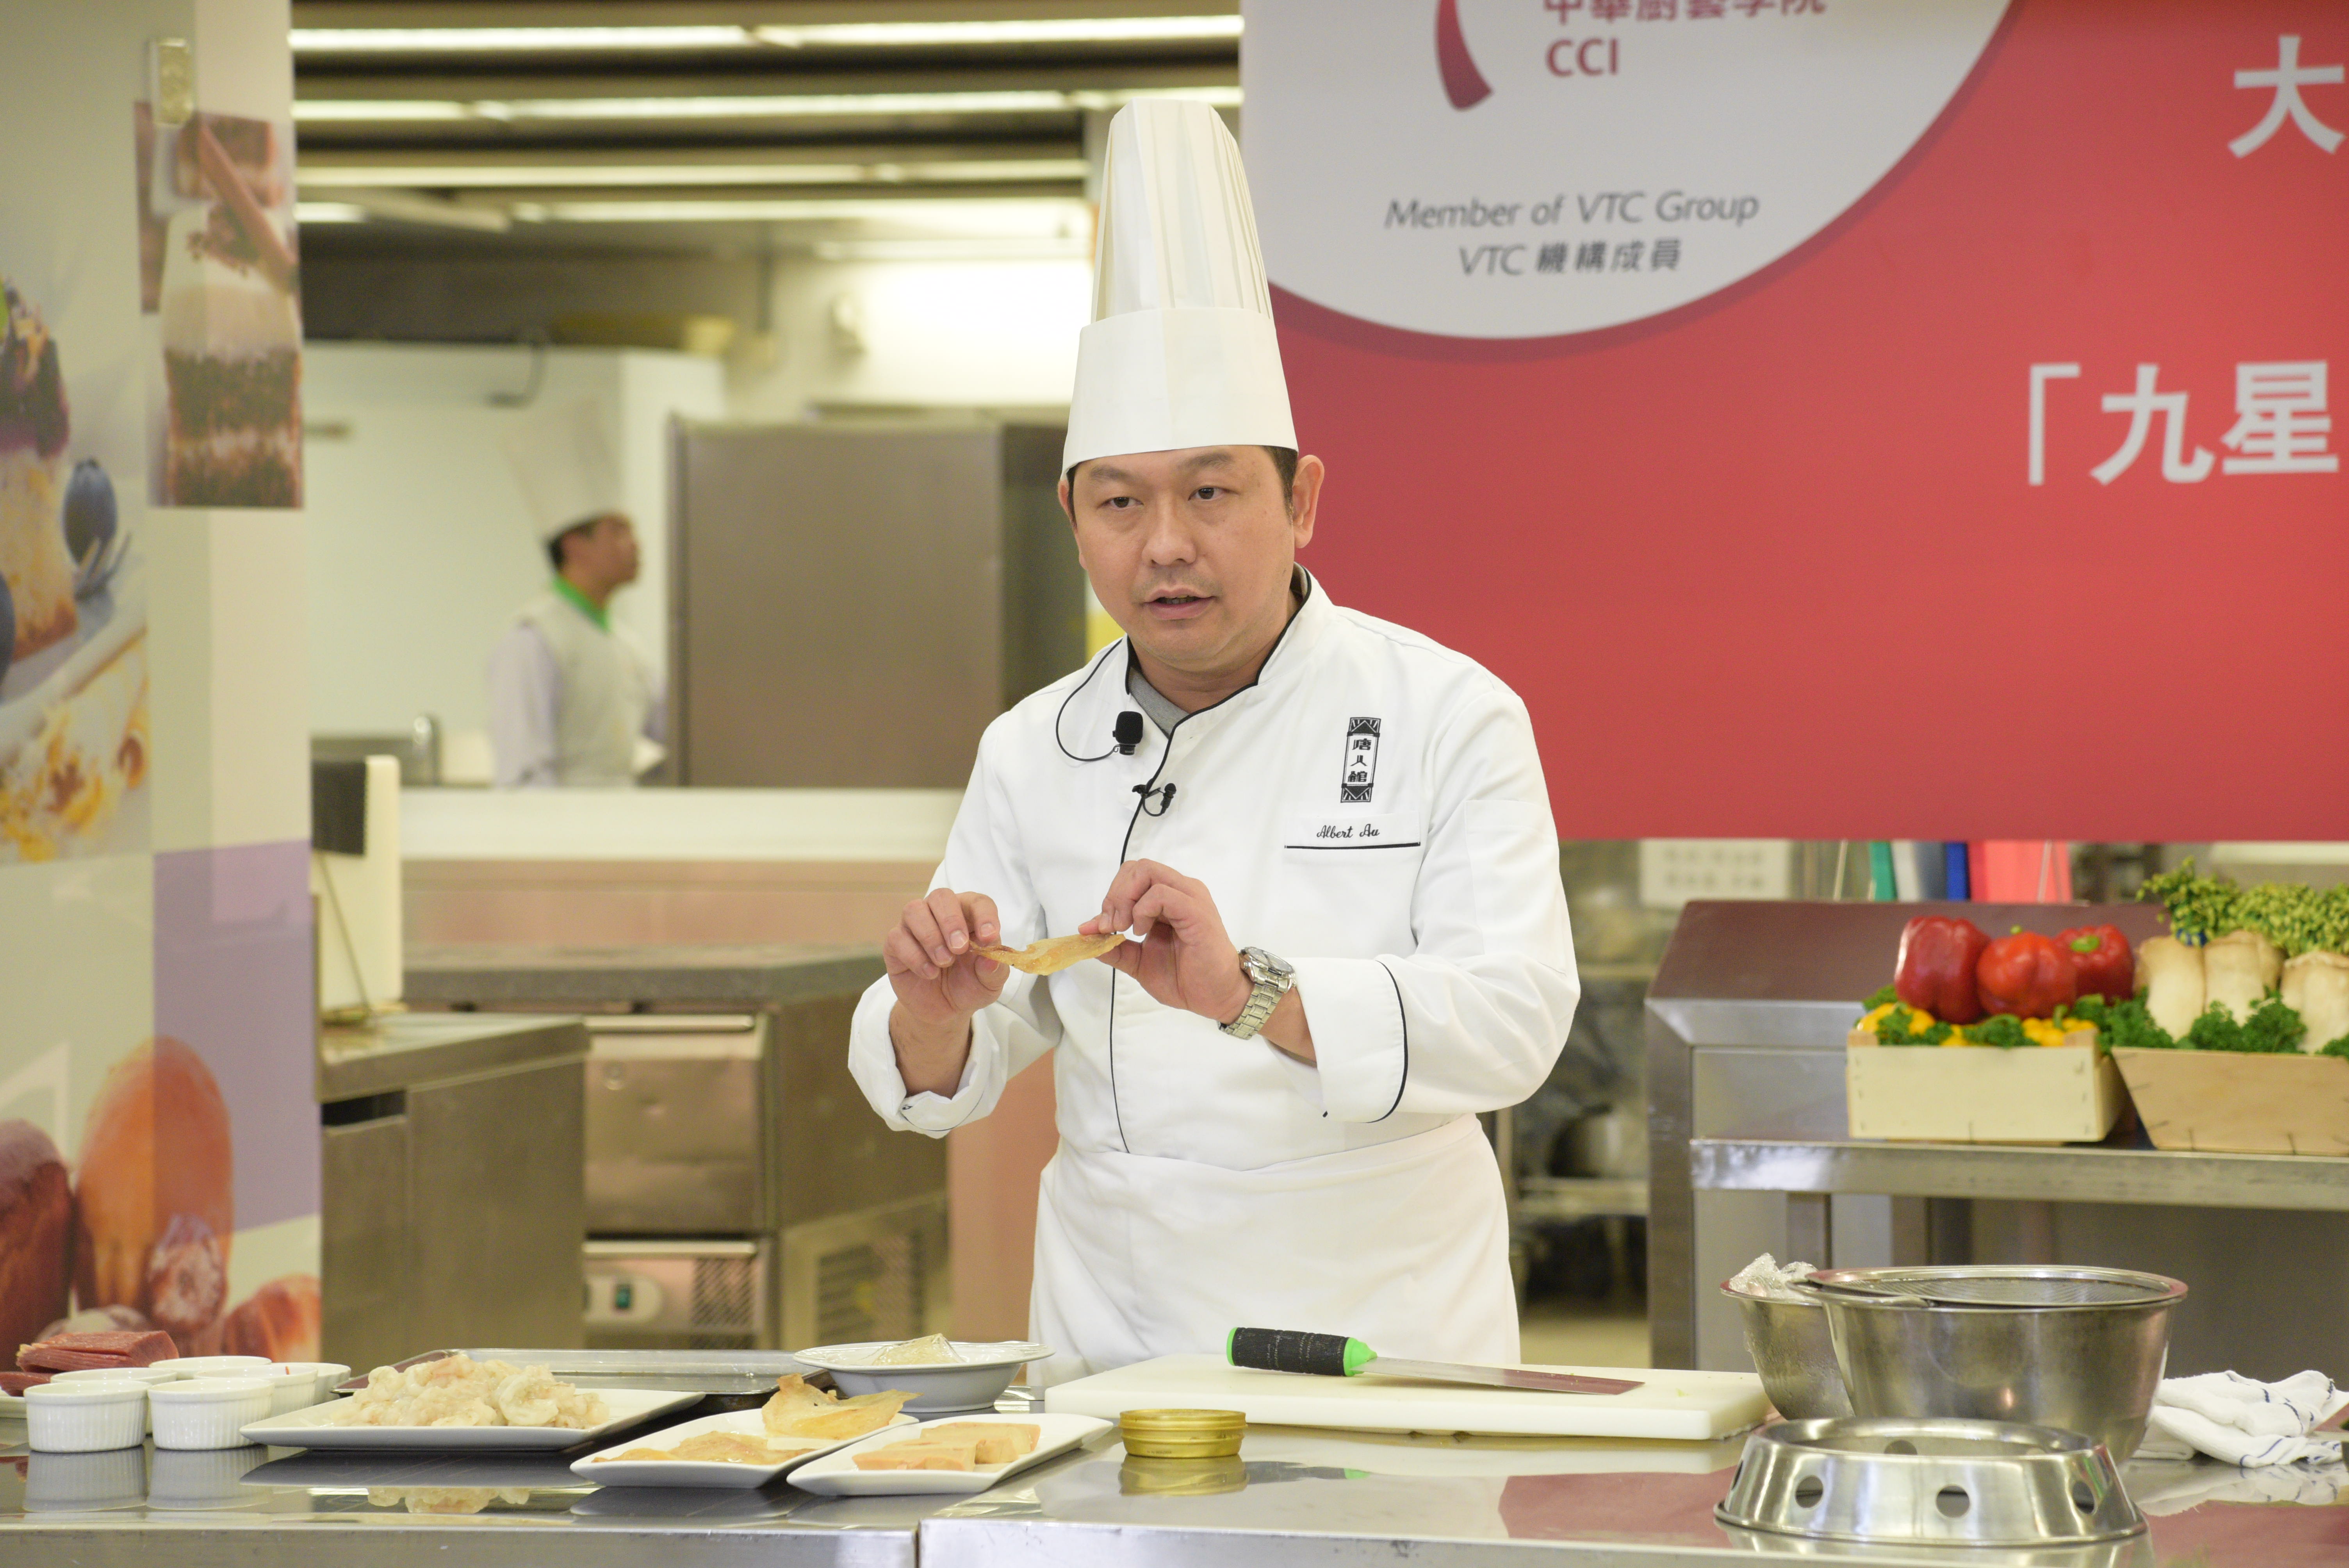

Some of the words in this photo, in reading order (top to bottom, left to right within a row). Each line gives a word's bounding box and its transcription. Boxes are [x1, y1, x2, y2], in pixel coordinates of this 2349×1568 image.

[1545, 38, 1619, 77] CCI
[2227, 34, 2346, 158] 大
[1385, 198, 1520, 228] Member
[1530, 195, 1566, 226] of
[1577, 191, 1645, 223] VTC
[1655, 190, 1760, 226] Group
[1459, 244, 1526, 276] VTC
[1536, 239, 1680, 273] 機構成員
[1316, 825, 1353, 839] Albert
[1359, 823, 1380, 837] Au
